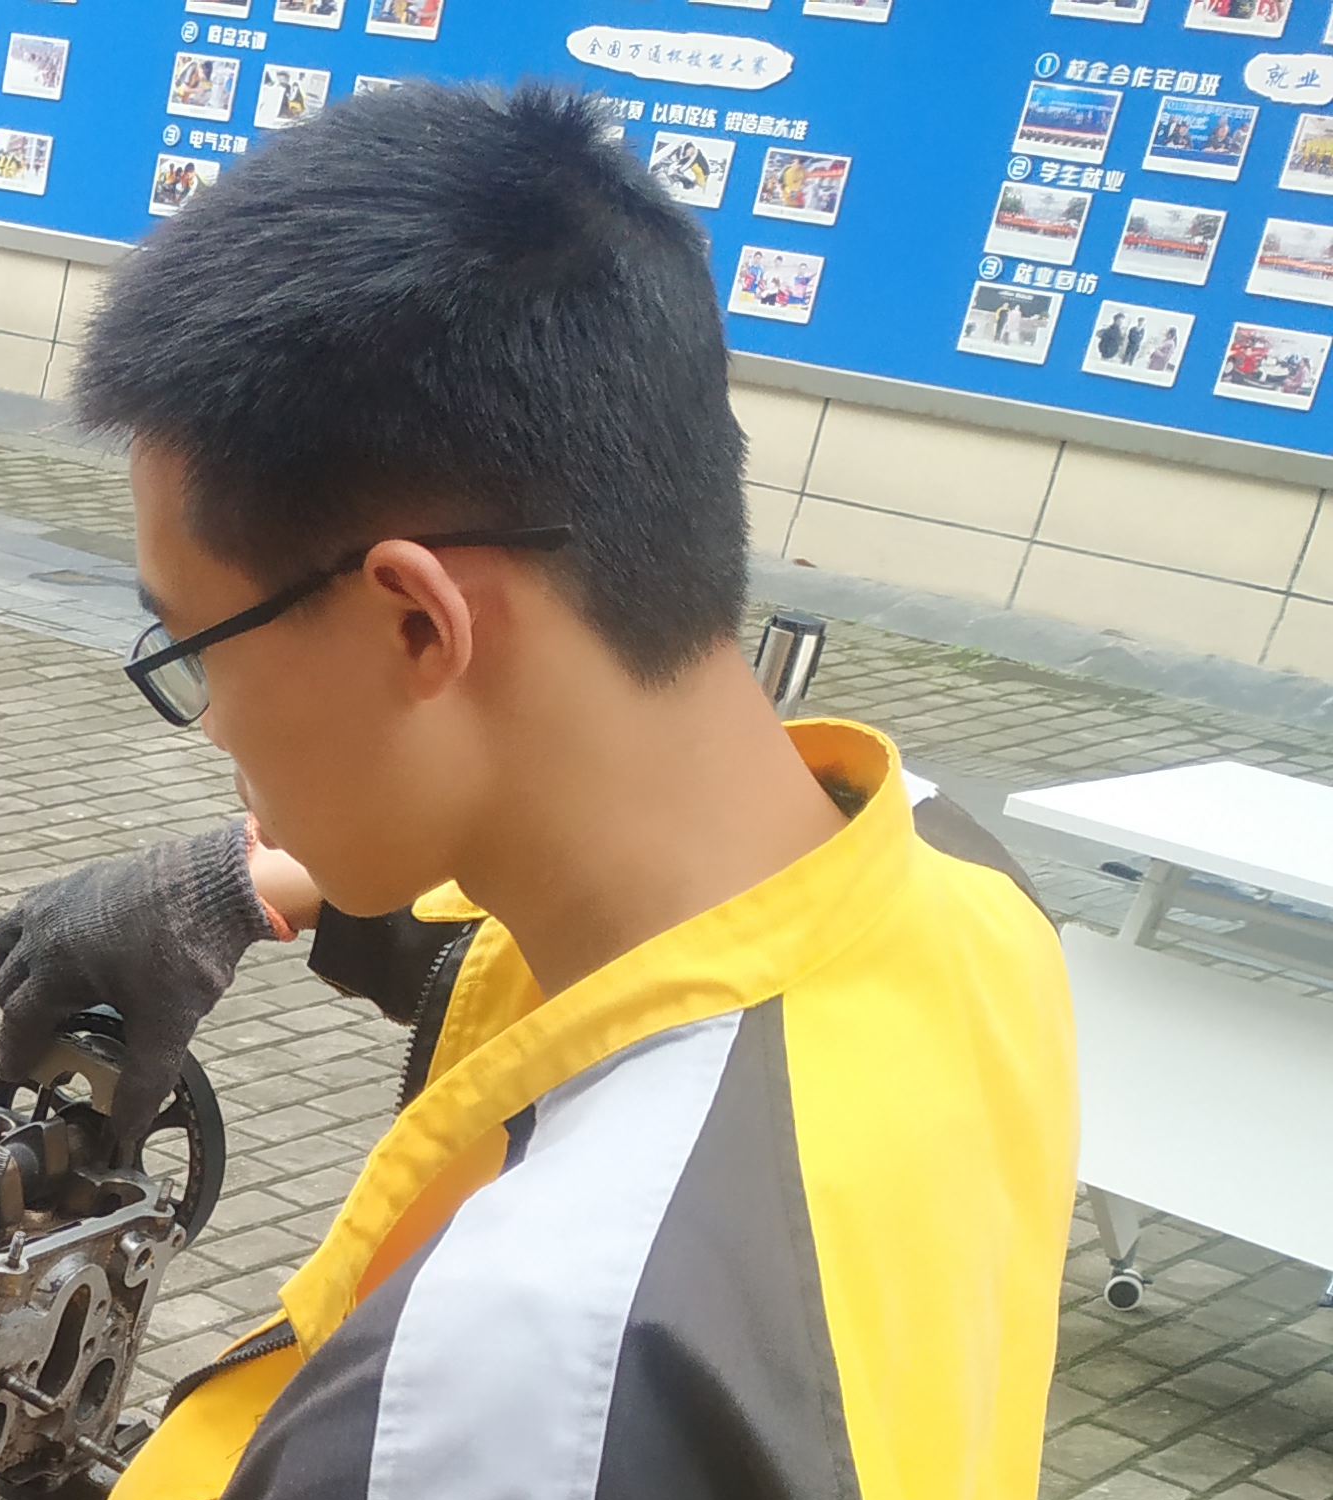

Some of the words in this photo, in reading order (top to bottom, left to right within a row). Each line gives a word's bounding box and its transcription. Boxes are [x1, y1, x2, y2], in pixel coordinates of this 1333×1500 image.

[587, 36, 769, 76] 全国万通杯技能大赛
[1065, 58, 1223, 96] 校企合作定向班
[1265, 62, 1321, 89] 就业
[651, 101, 719, 129] 以赛促练
[724, 111, 809, 141] 锻造高水准
[1039, 161, 1127, 193] 学生就业
[1012, 261, 1100, 295] 就业回访
